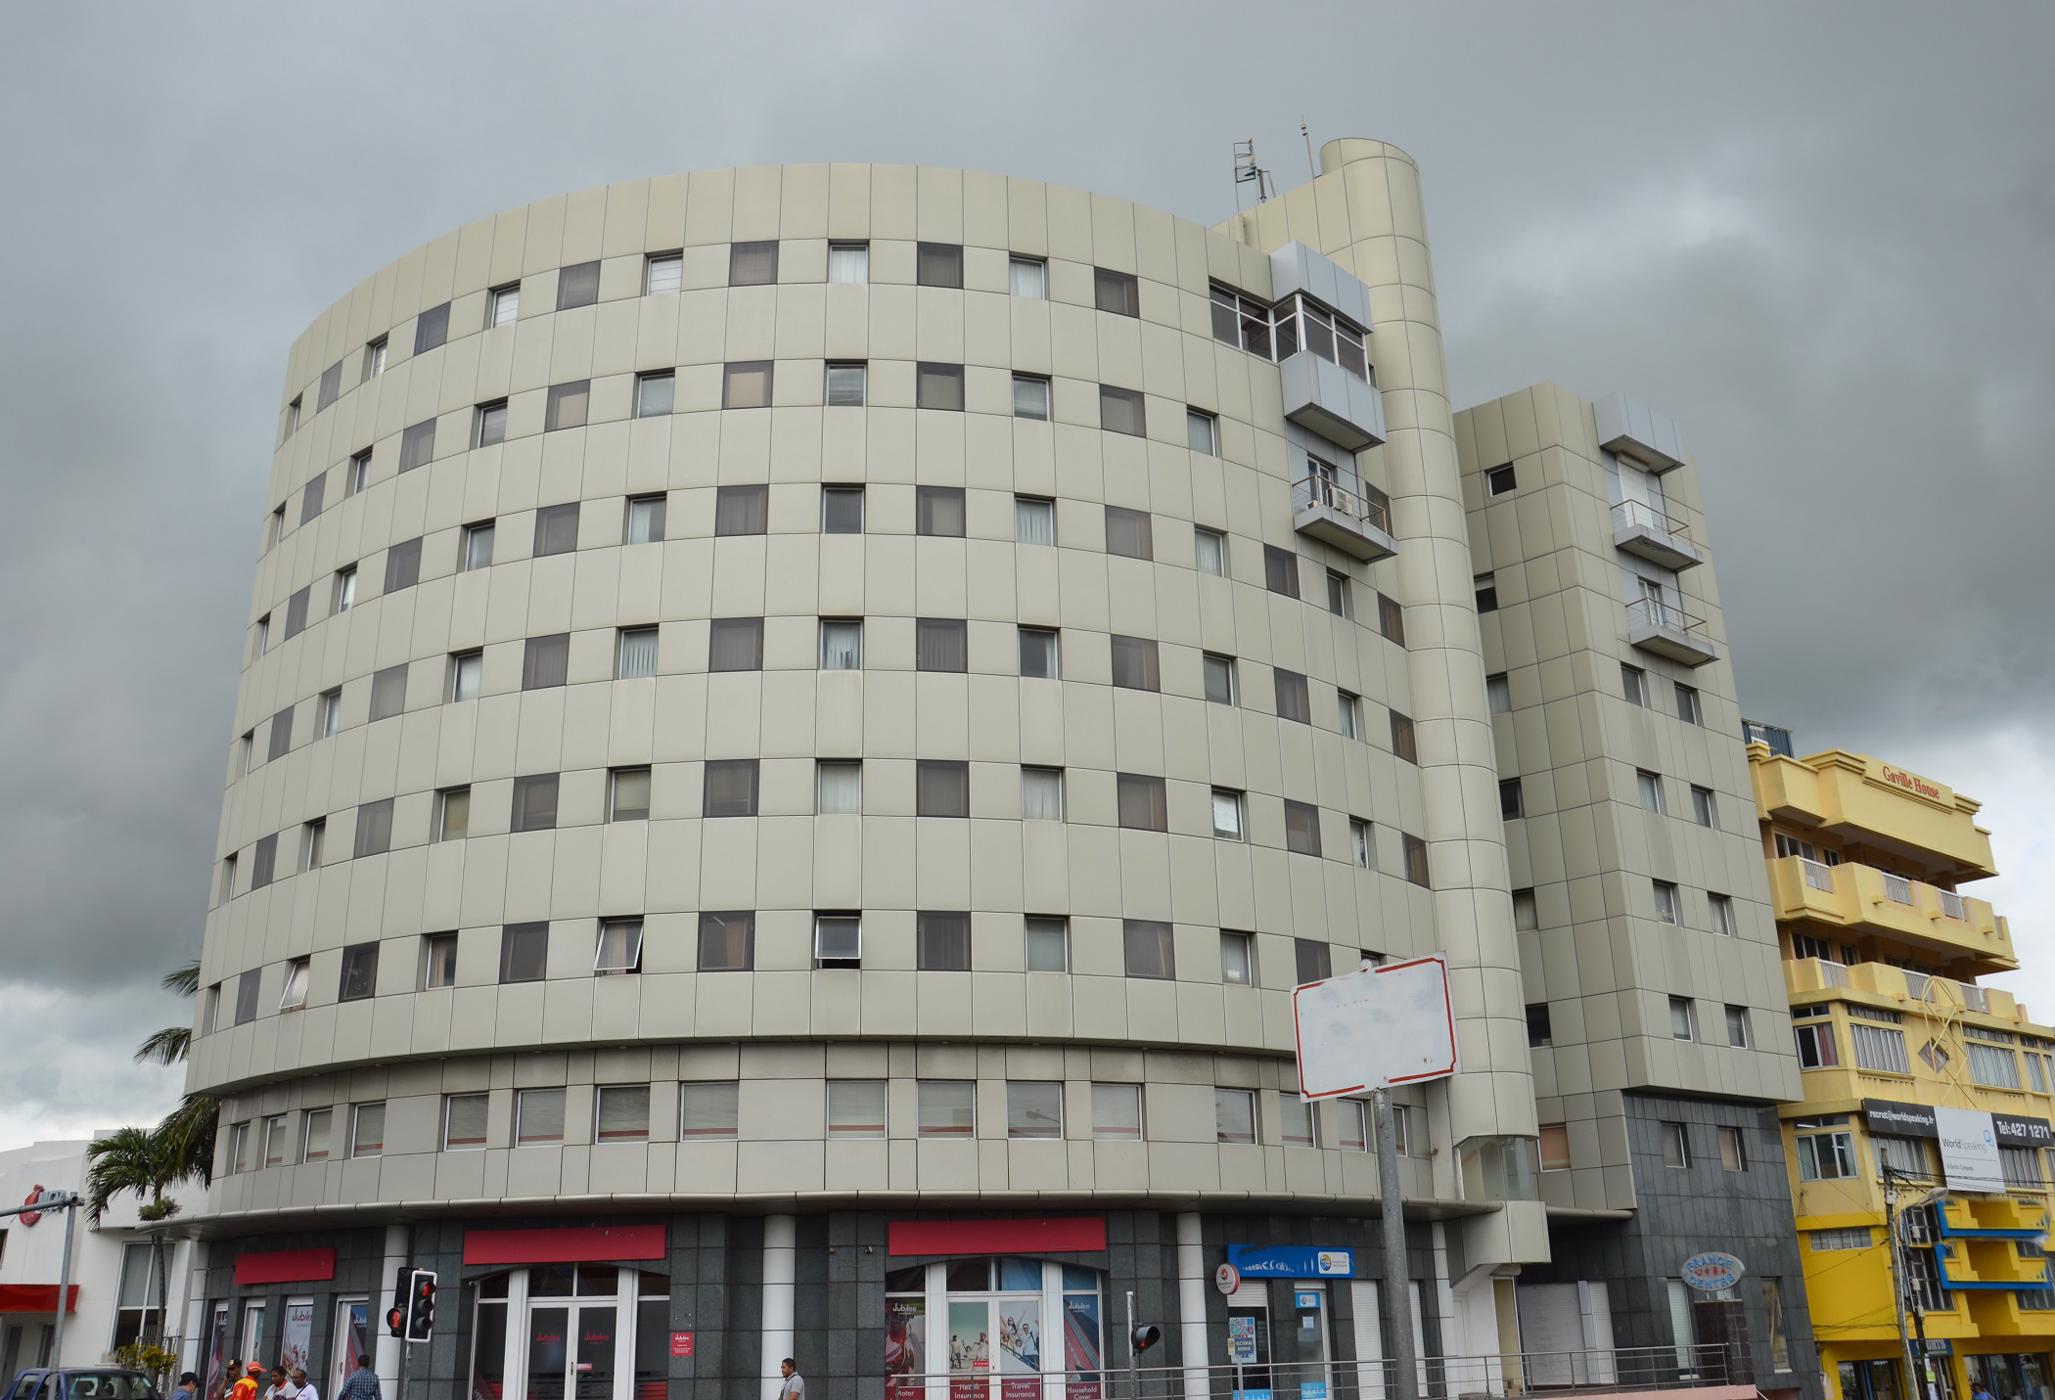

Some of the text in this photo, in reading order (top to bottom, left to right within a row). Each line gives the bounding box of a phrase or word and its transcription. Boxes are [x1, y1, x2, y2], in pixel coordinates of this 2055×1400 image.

[1882, 765, 1941, 800] Gaville House
[2028, 1125, 2051, 1140] 1271
[892, 1302, 917, 1312] Jubilee
[1068, 1300, 1091, 1310] Jubilee
[292, 1308, 313, 1322] Jubile
[1005, 1390, 1036, 1399] Insurance
[1067, 1385, 1098, 1394] Household
